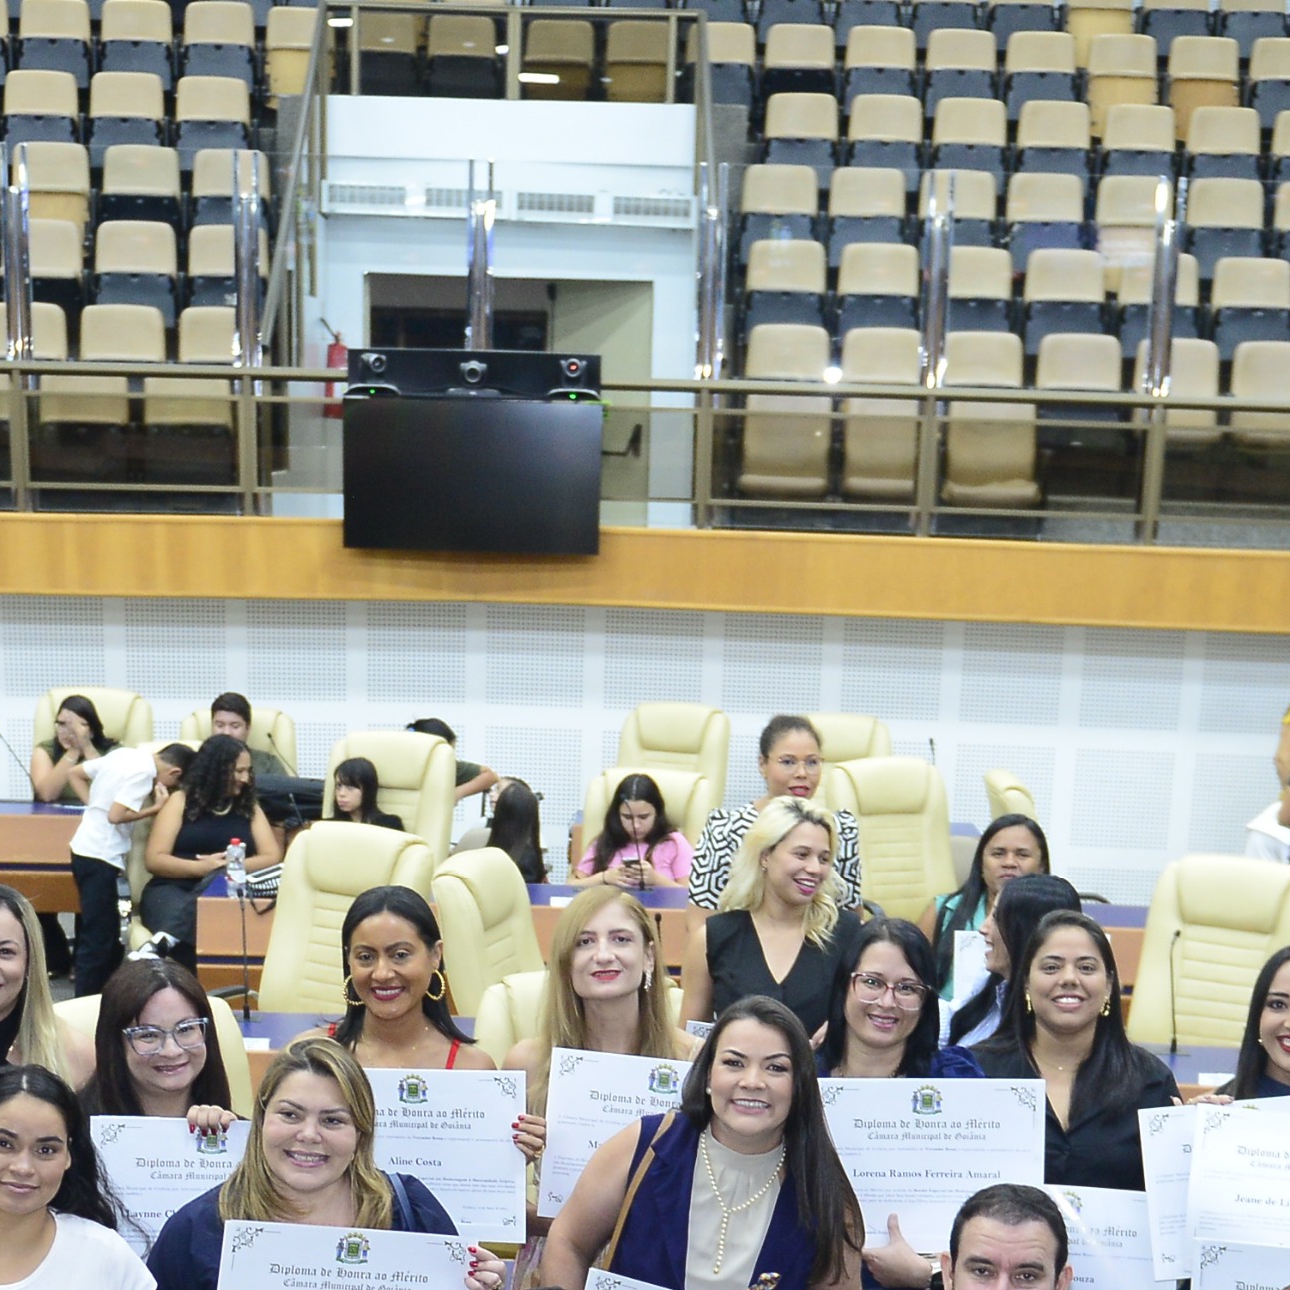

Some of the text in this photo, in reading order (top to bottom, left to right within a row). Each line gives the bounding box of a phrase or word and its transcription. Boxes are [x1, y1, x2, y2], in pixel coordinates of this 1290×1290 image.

[589, 1090, 631, 1104] Diploma
[635, 1096, 645, 1106] de
[387, 1108, 398, 1116] de
[450, 1108, 485, 1120] Mérito
[389, 1121, 428, 1130] Municipal
[430, 1122, 438, 1130] de
[853, 1118, 897, 1130] Diploma
[900, 1120, 911, 1130] de
[965, 1118, 1001, 1130] Mérito
[901, 1132, 940, 1141] Municipal
[943, 1132, 951, 1140] de
[1237, 1145, 1280, 1160] Diploma
[135, 1158, 179, 1169] Diploma
[184, 1159, 195, 1168] de
[389, 1156, 442, 1166] Aline Costa
[853, 1169, 1001, 1179] Lorena Ramos Ferreira Amaral
[1235, 1194, 1263, 1205] Jeane
[1265, 1198, 1277, 1206] de
[269, 1264, 429, 1284] Diploma de Honra ao Mérito
[1073, 1276, 1095, 1284] ouza
[283, 1278, 317, 1290] Câmara
